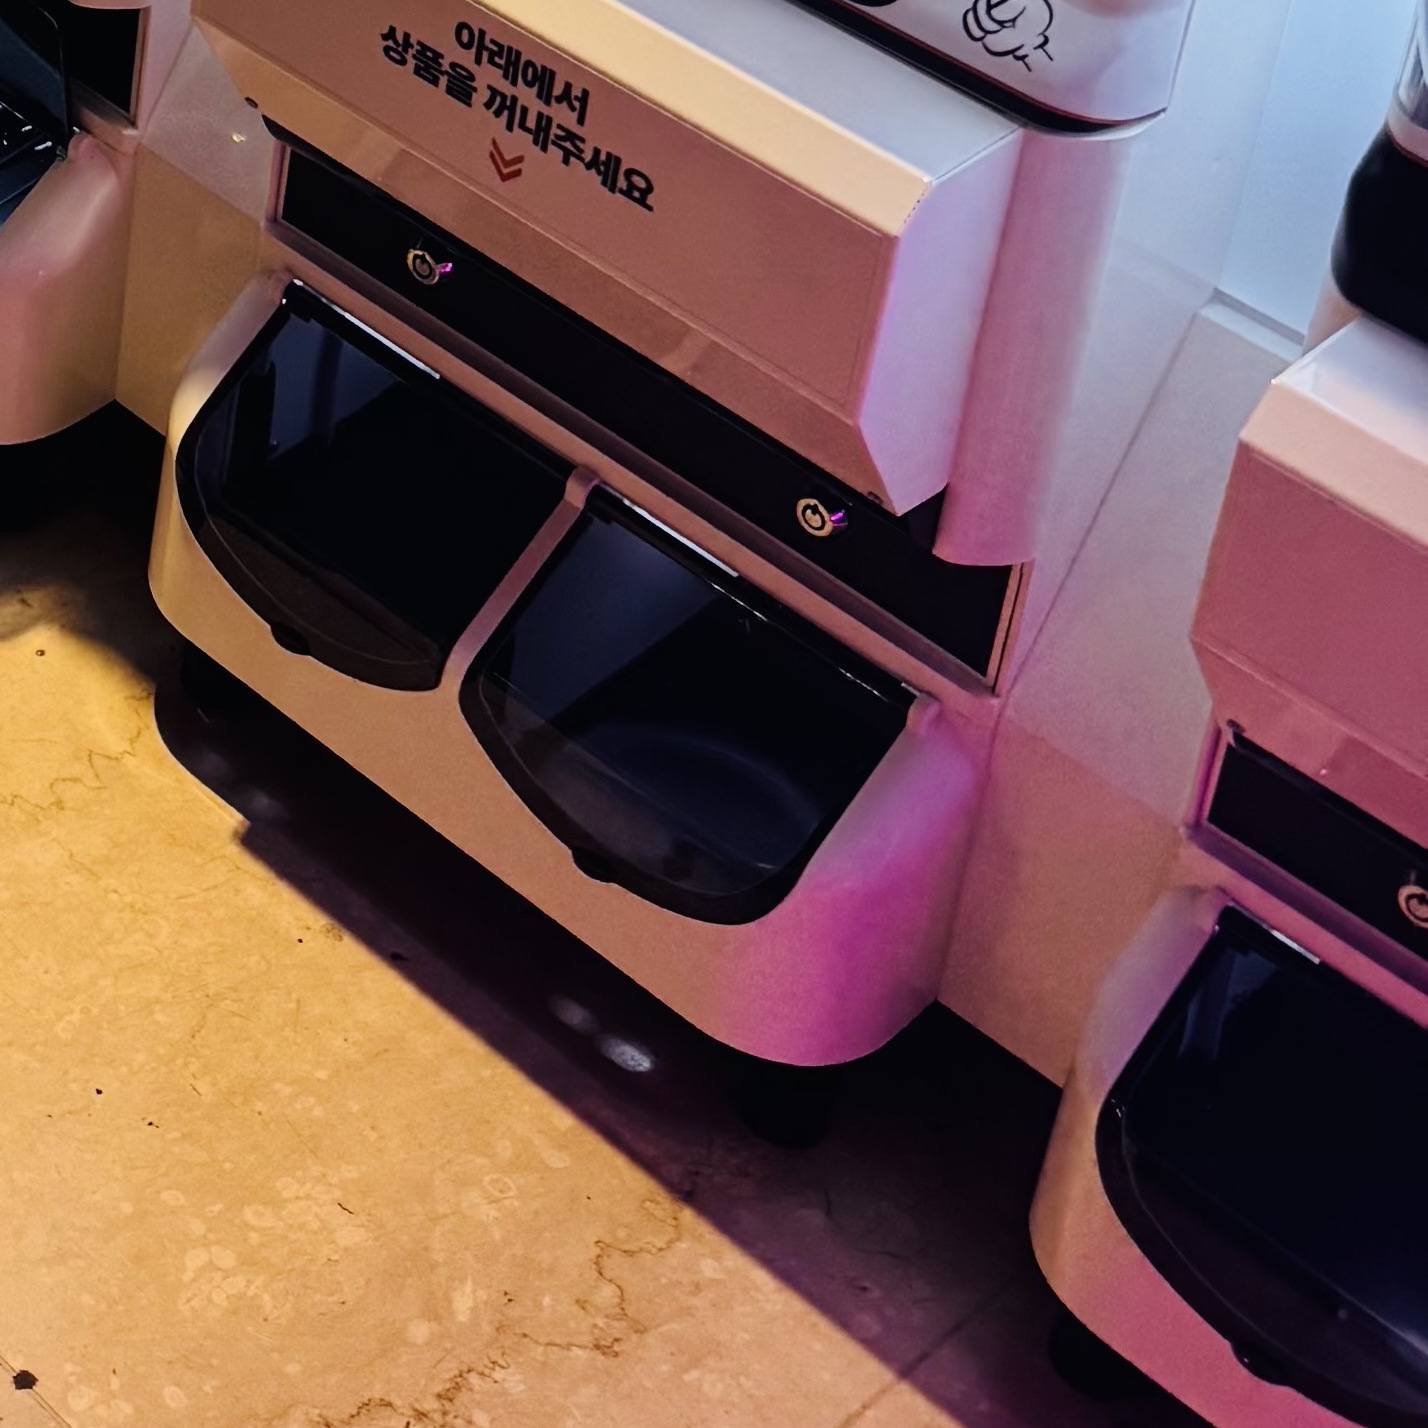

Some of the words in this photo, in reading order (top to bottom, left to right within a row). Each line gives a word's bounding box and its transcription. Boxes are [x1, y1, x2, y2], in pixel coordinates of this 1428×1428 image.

[380, 22, 479, 107] 상품을
[481, 87, 658, 213] 꺼내주세요
[453, 19, 591, 125] 아래에서
